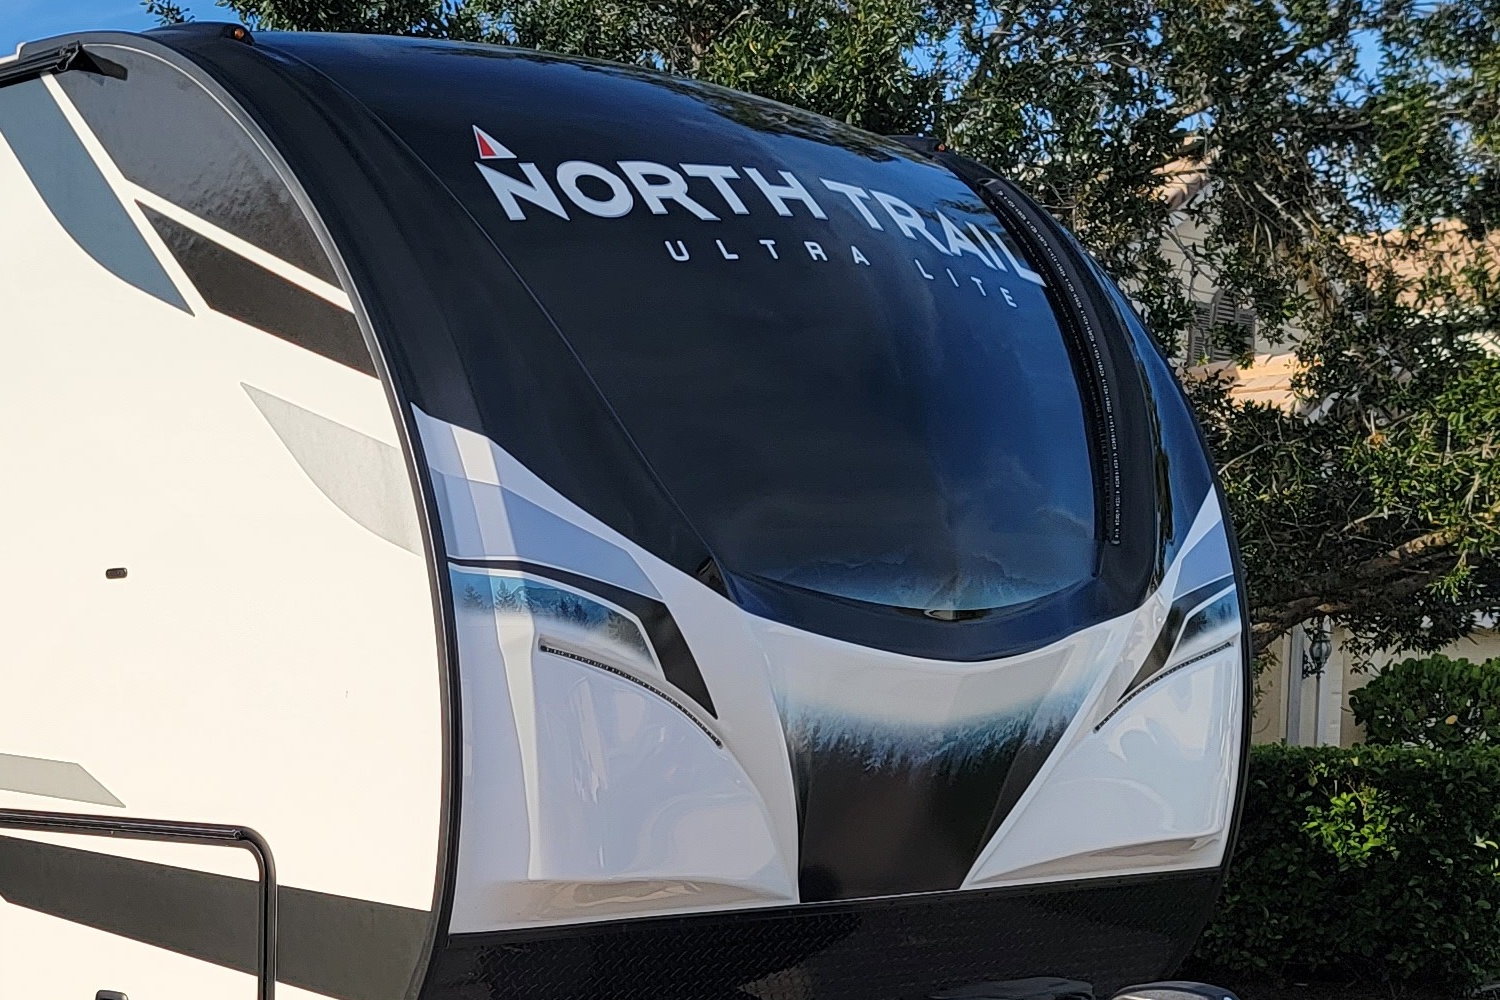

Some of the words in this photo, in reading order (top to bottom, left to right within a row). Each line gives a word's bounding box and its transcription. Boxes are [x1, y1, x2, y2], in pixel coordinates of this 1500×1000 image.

[475, 160, 828, 221] NORTH
[821, 177, 1047, 287] TRAIL
[664, 239, 870, 266] ULTRA
[915, 258, 1018, 308] LITE
